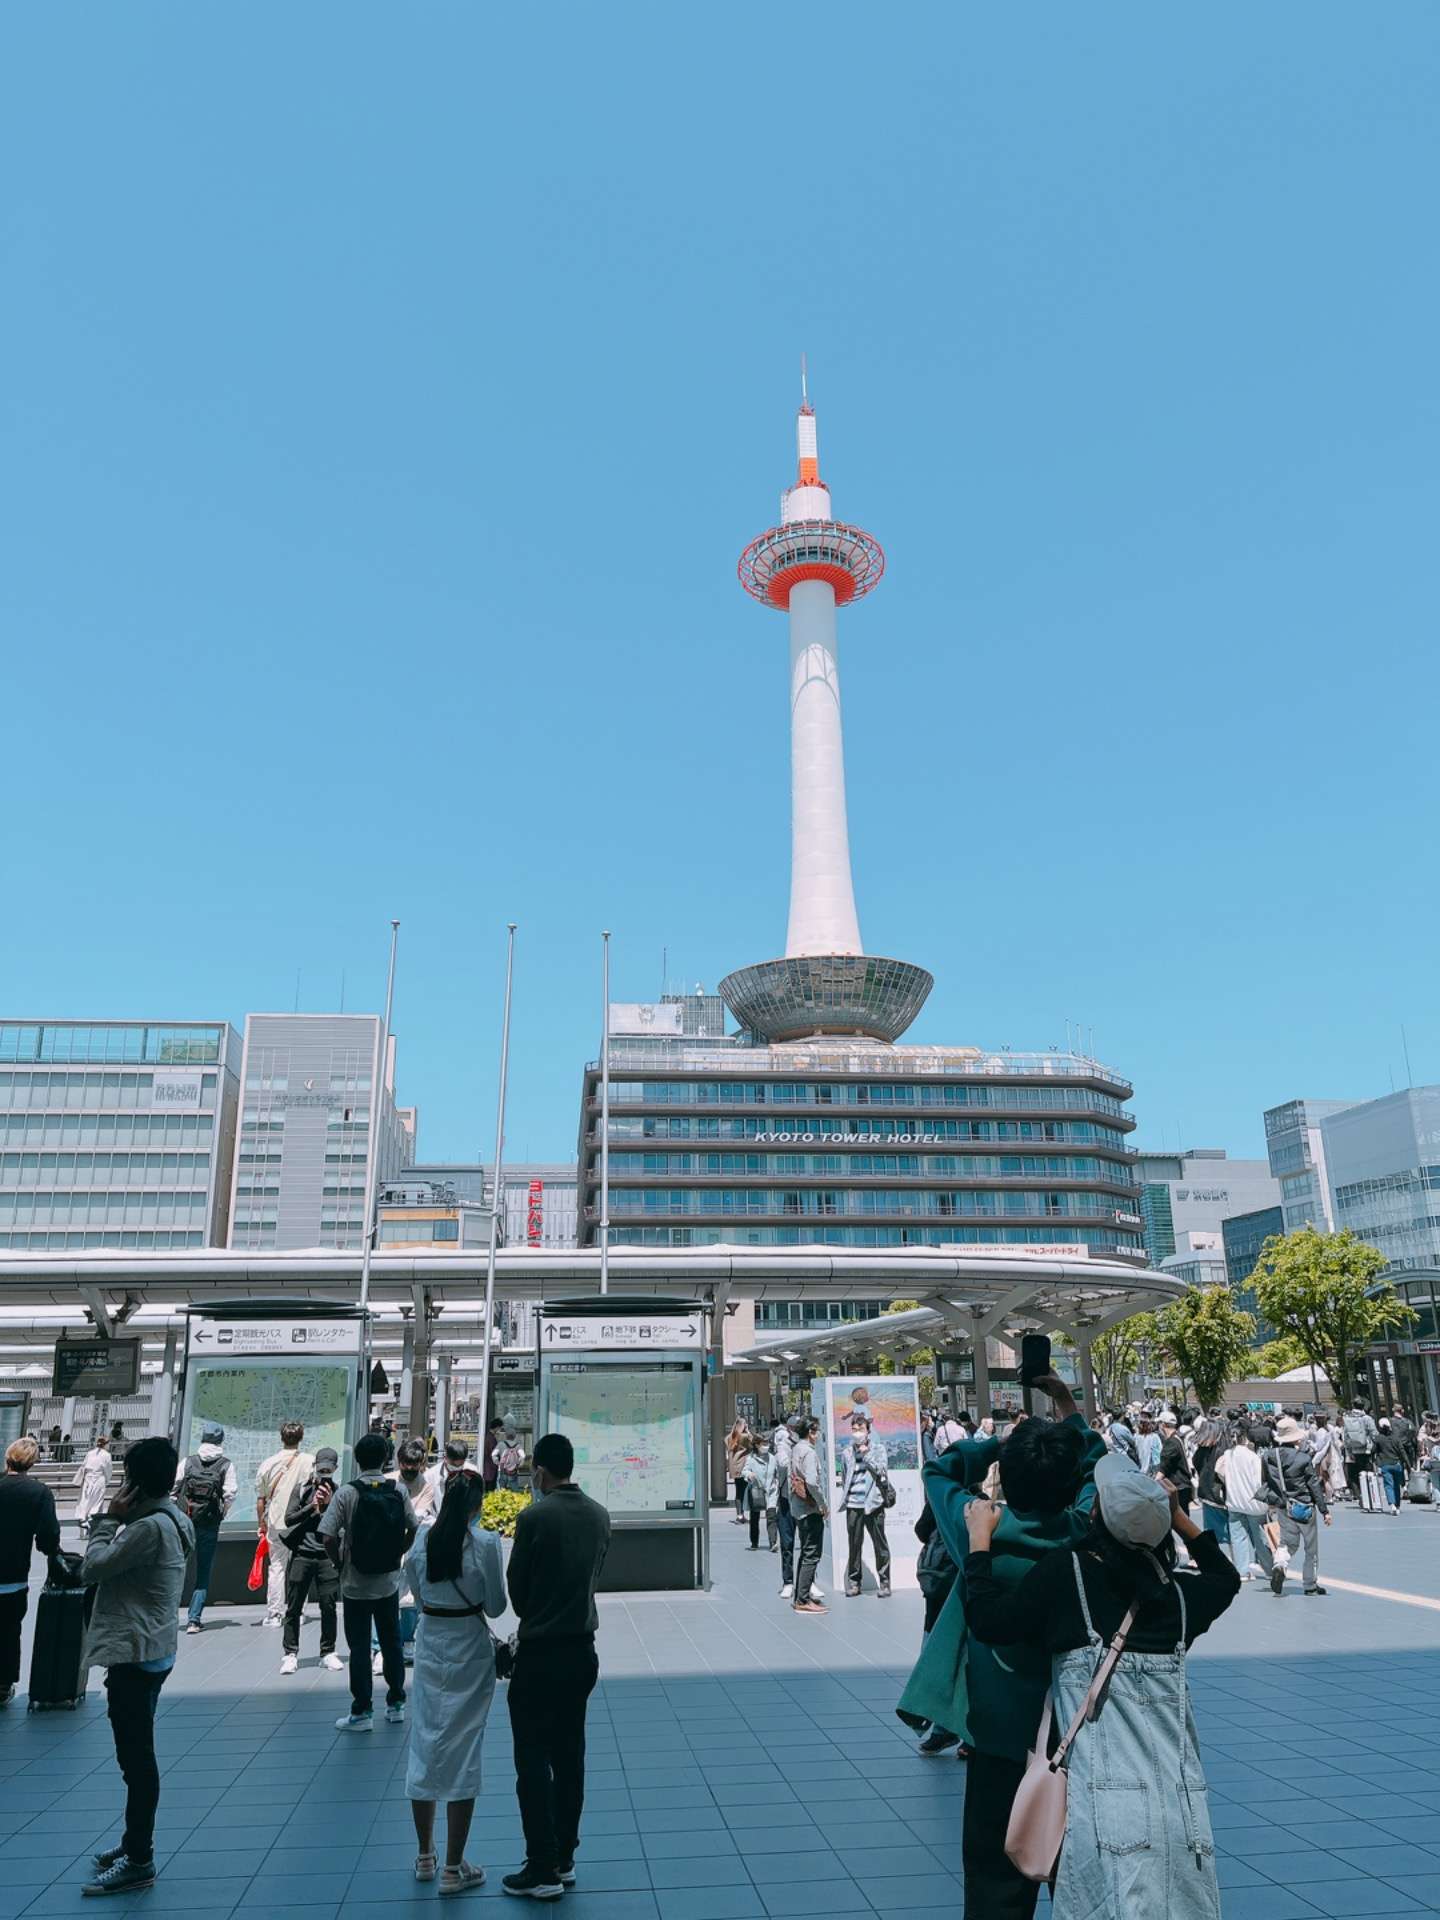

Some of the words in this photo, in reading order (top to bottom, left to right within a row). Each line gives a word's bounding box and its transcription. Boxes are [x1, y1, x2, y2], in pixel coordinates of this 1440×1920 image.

[754, 1132, 814, 1143] KYOTO
[820, 1133, 881, 1144] TOWER
[887, 1133, 944, 1144] HOTEL
[528, 1179, 543, 1248] ヨドバシ
[308, 1328, 354, 1338] 駅レンタカー
[573, 1326, 587, 1334] バス
[615, 1325, 637, 1334] 地下鉄
[652, 1325, 679, 1334] タクシー
